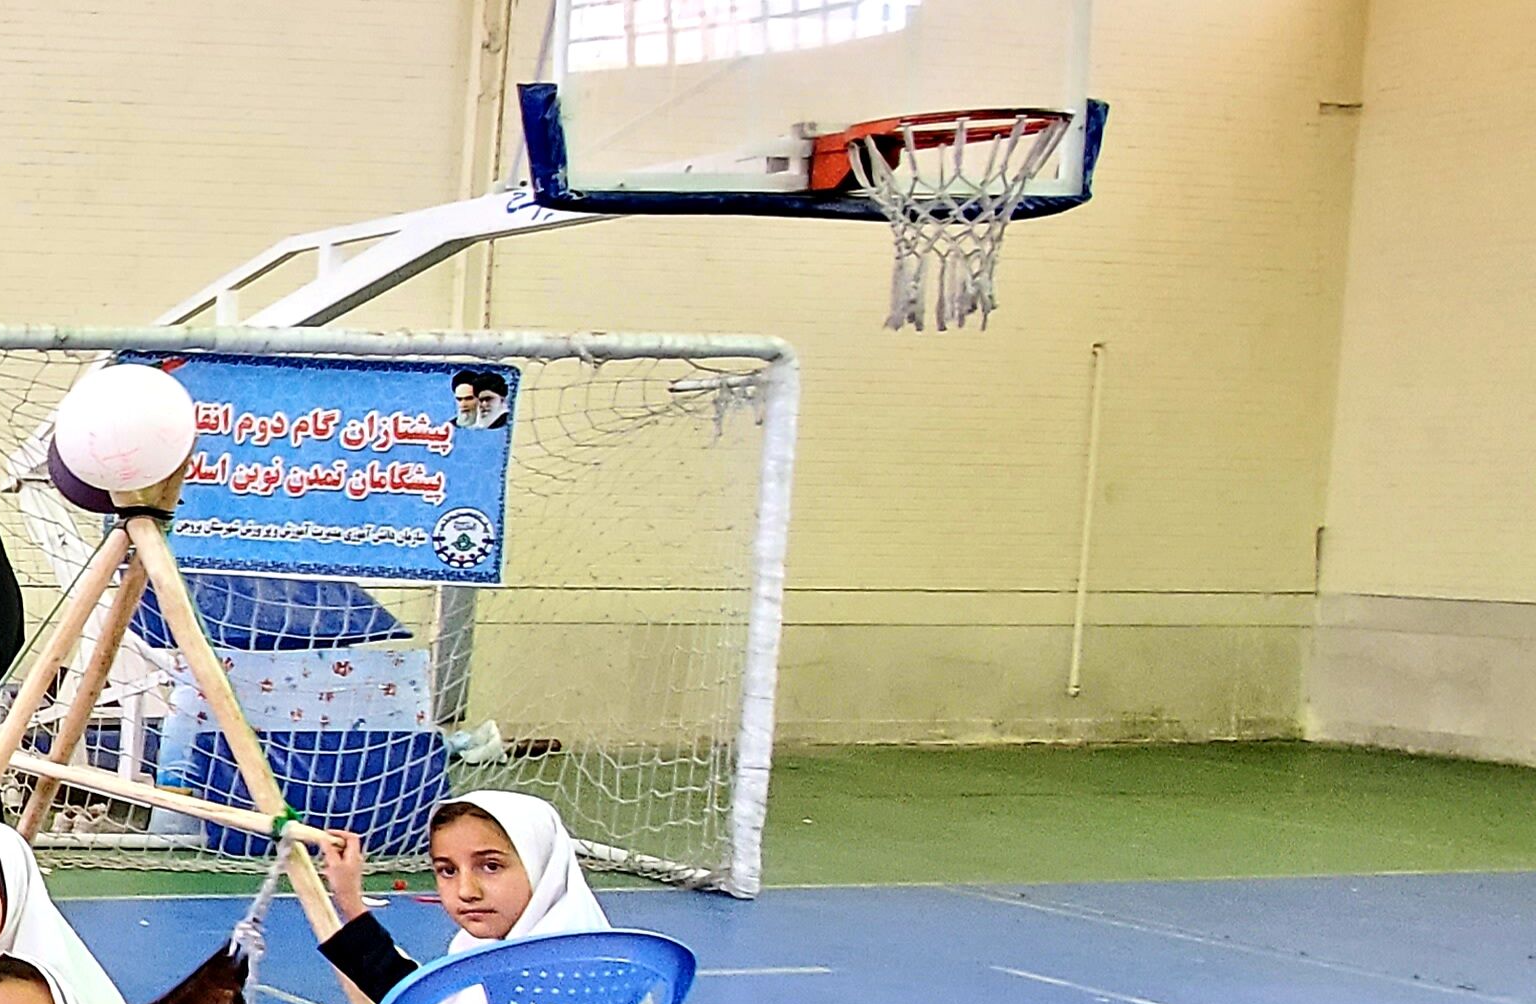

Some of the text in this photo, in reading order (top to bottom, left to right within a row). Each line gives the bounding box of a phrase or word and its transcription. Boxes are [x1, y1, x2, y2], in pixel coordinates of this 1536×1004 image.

[236, 414, 286, 443] دوم
[291, 410, 337, 445] گام
[342, 413, 451, 453] پیشتازان
[184, 454, 443, 502] پیشگامان تمدن نوین اسلا
